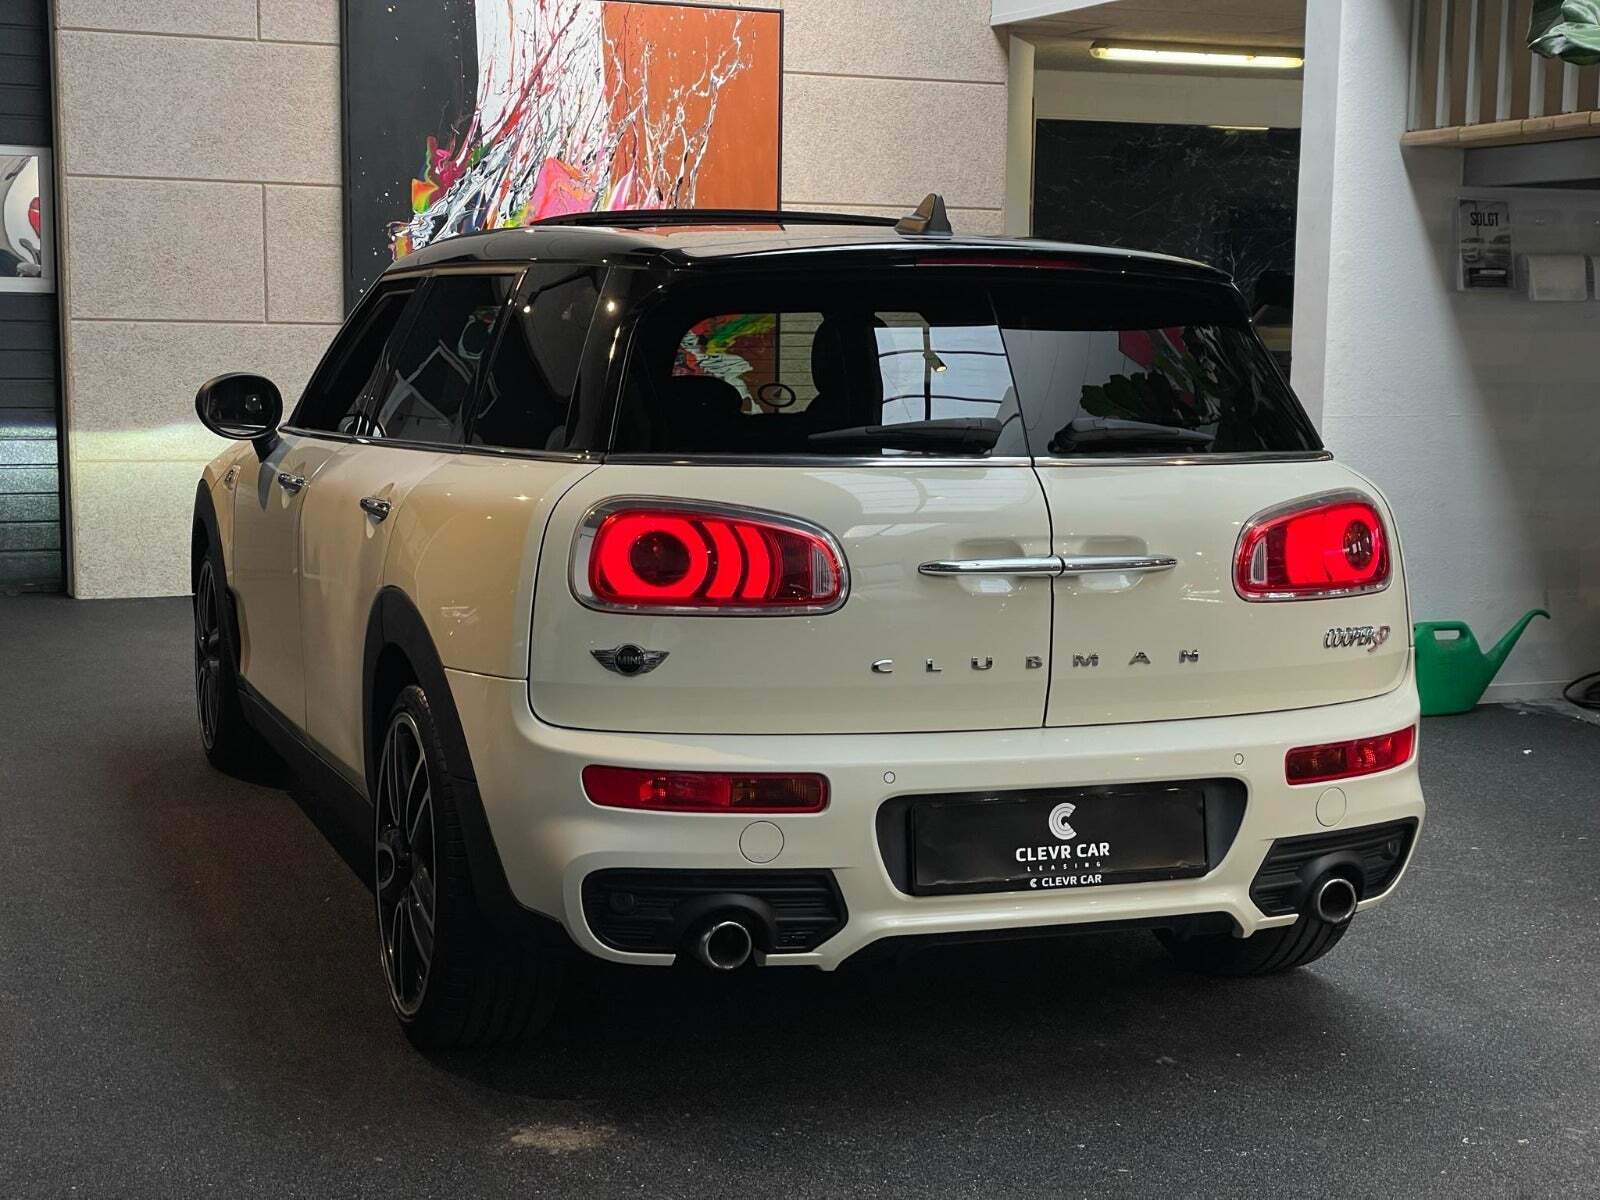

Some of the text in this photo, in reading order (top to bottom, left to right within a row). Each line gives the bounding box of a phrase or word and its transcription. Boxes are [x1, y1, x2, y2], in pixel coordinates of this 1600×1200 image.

[870, 649, 1200, 674] CLUBMAN
[1015, 842, 1110, 861] CLEVR CAR
[1041, 876, 1078, 888] CLEVR
[1080, 874, 1103, 885] CAR
